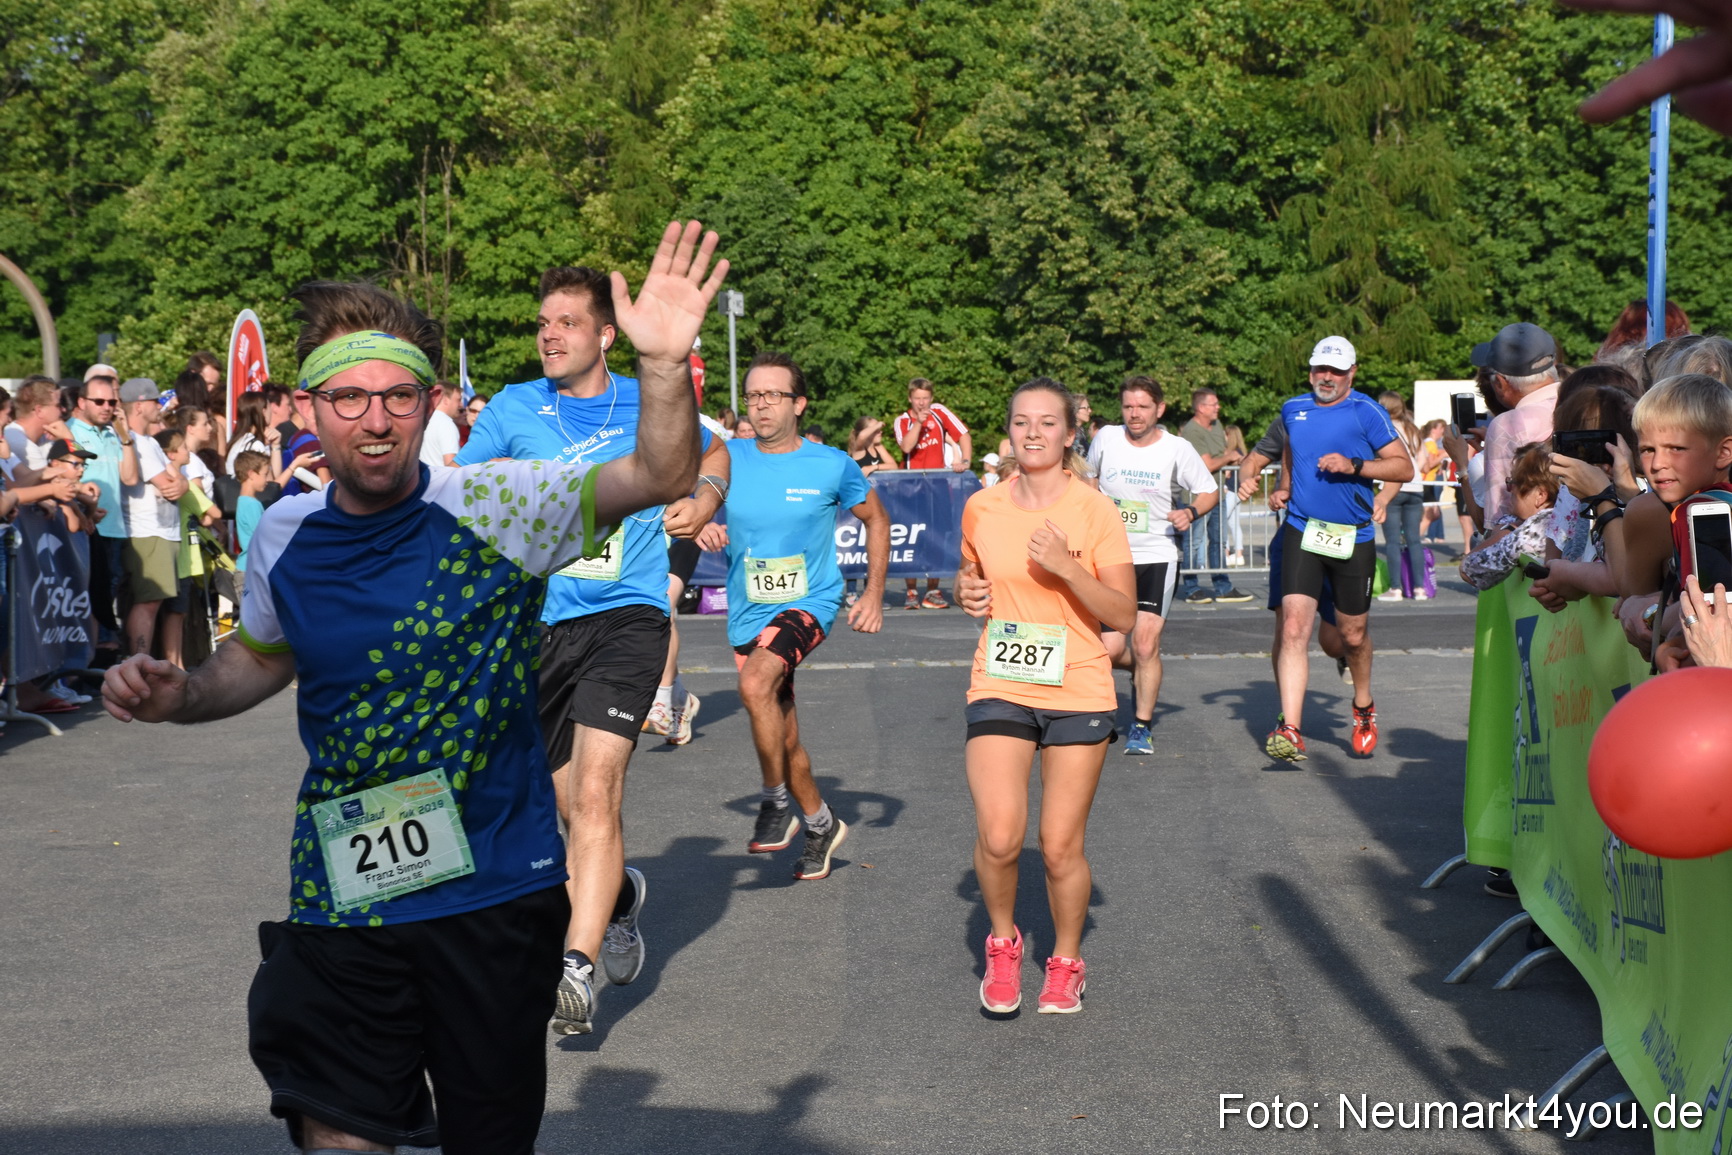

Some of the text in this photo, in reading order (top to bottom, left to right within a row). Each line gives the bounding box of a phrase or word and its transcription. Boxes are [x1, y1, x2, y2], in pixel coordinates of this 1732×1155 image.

[562, 436, 599, 456] Schick
[599, 427, 624, 440] Bau
[1120, 468, 1161, 480] HAUBNER
[1124, 477, 1156, 487] TREPPEN
[1121, 511, 1138, 524] 99
[1315, 531, 1342, 548] 574
[578, 561, 603, 569] Thomas
[753, 572, 798, 591] 1847
[995, 641, 1054, 667] 2287
[1001, 663, 1046, 674] Bytom Hannah
[617, 711, 635, 722] JAKO
[418, 799, 445, 816] 2019
[349, 818, 430, 875] 210
[364, 857, 432, 884] Franz Simon
[376, 870, 424, 891] Bionorica SE
